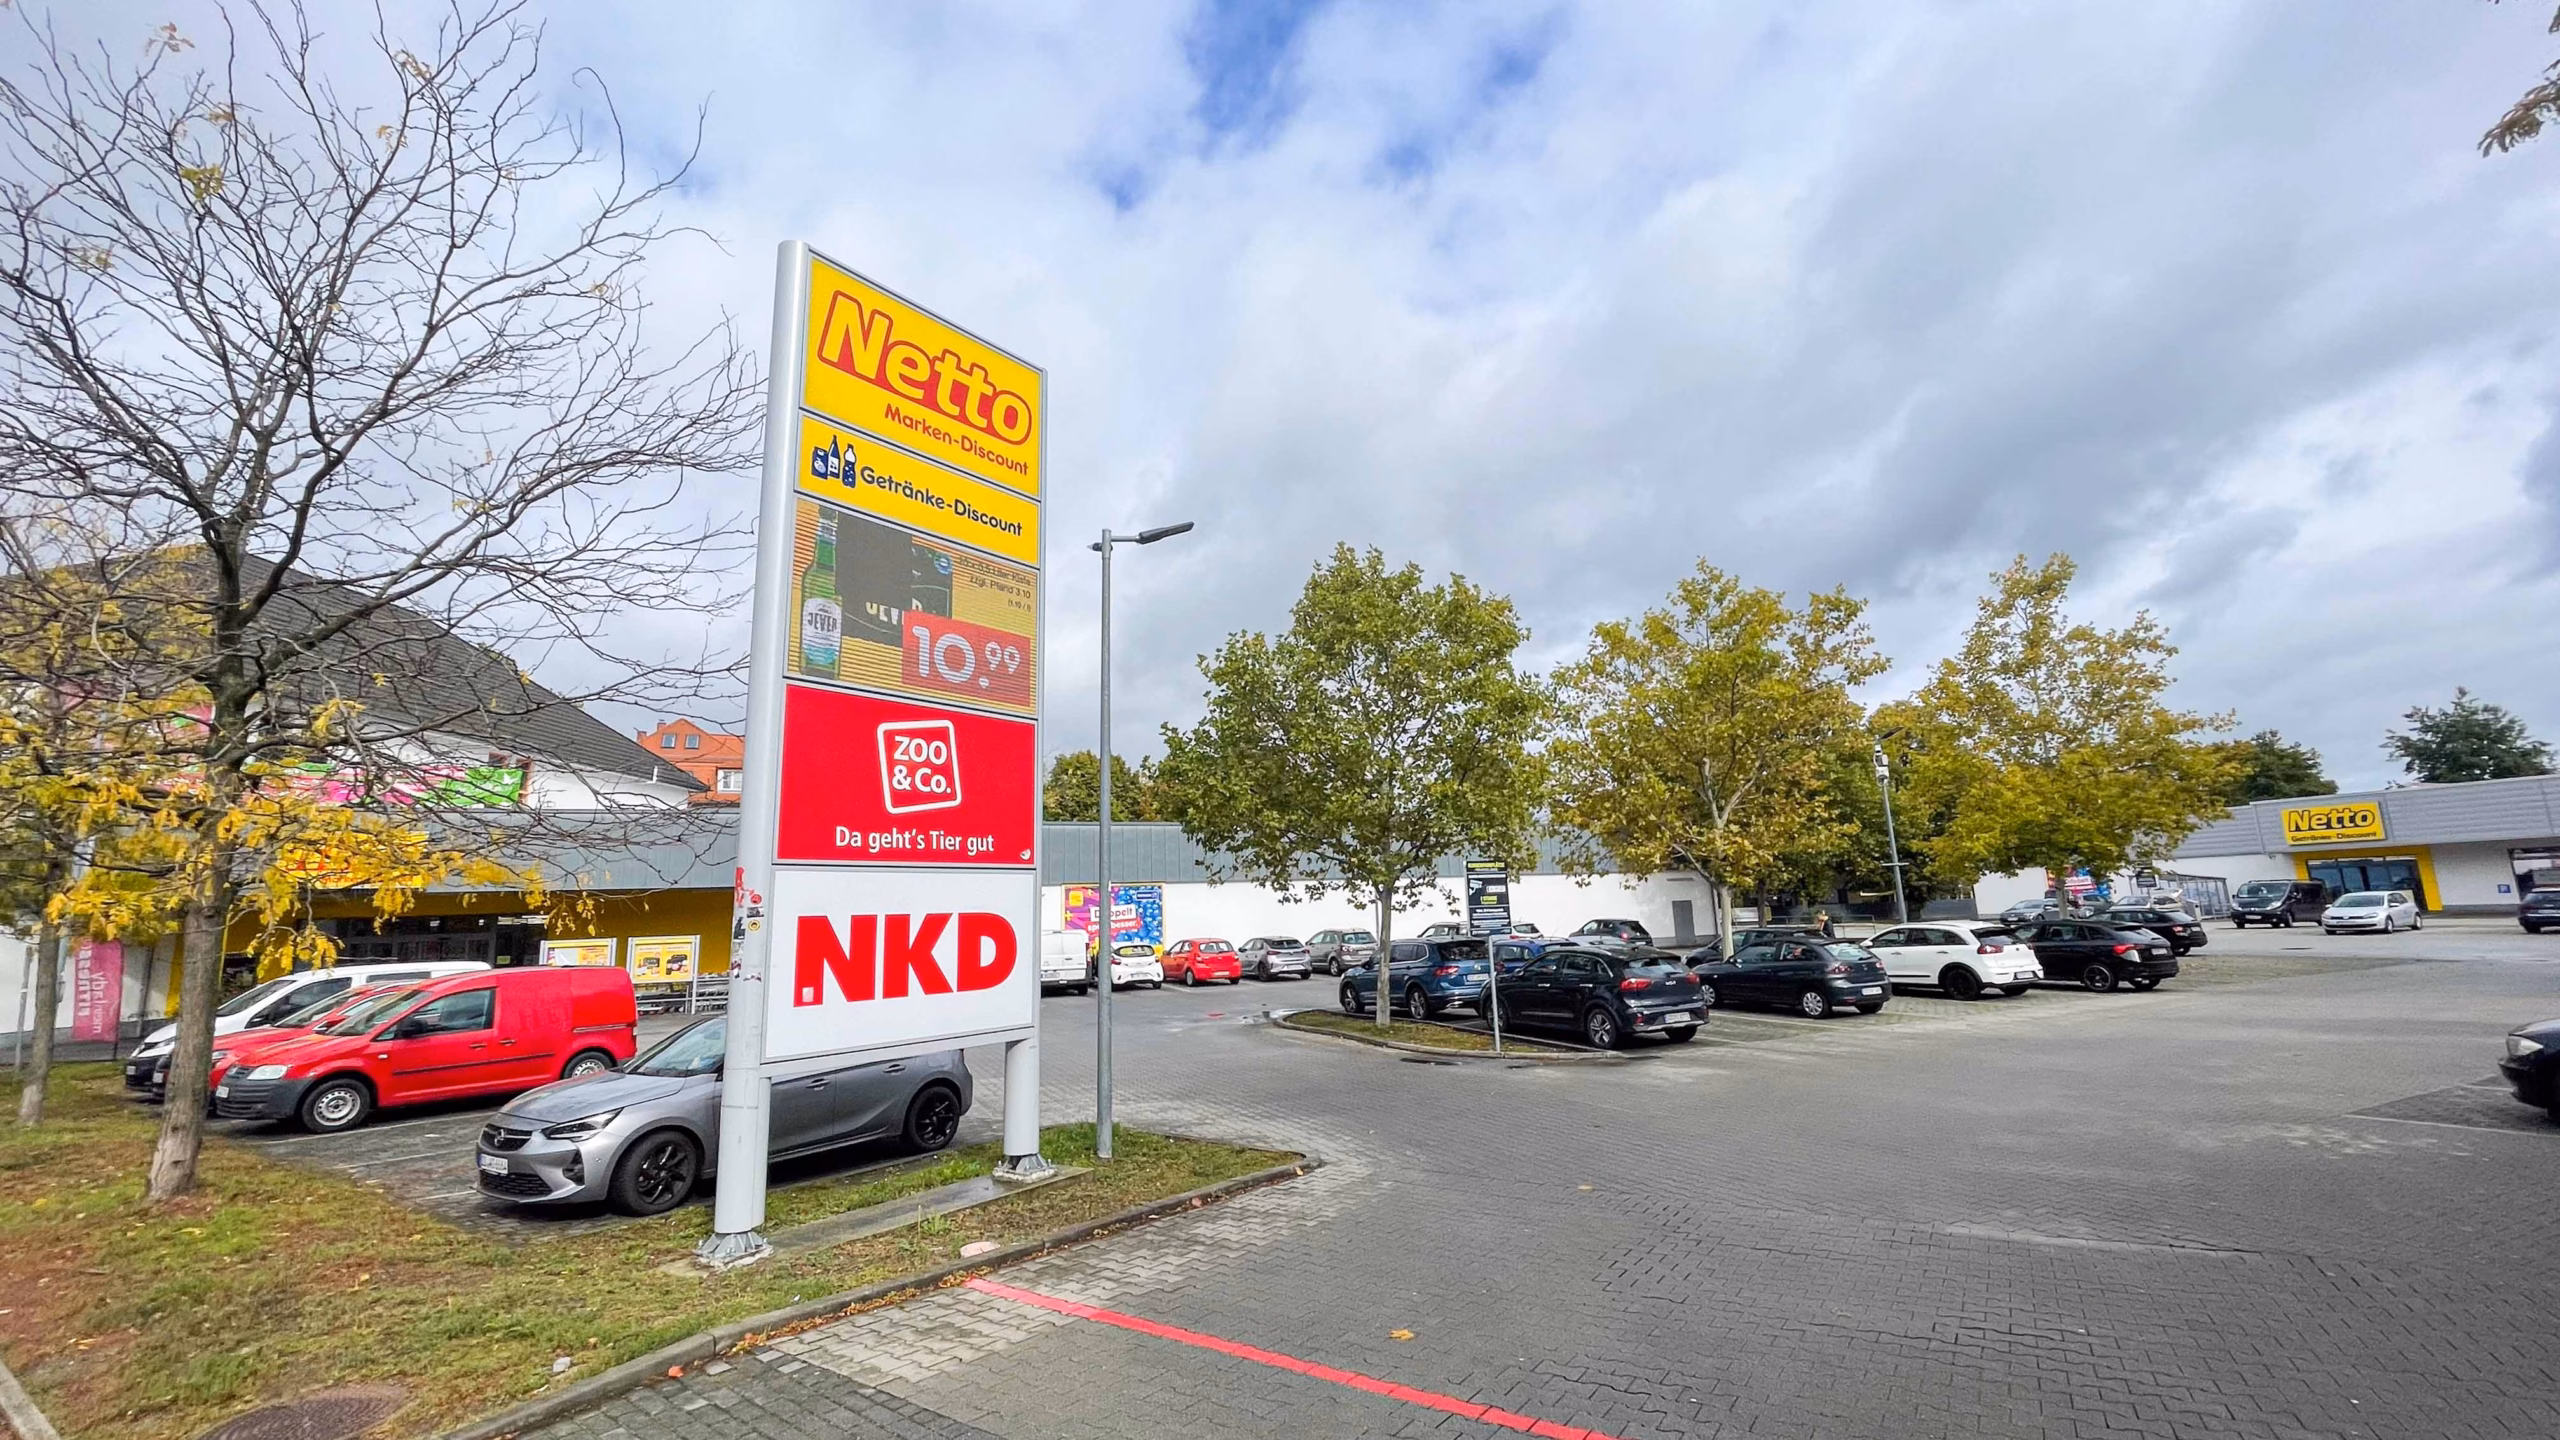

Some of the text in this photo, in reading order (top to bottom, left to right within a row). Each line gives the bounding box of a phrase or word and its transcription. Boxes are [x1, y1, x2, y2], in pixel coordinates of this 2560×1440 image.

[818, 290, 1032, 445] Netto
[885, 403, 1029, 476] Marken-Discount
[860, 466, 1023, 537] Getränke-Discount
[808, 612, 837, 632] JEVER
[912, 626, 1021, 689] 10.99
[893, 735, 947, 765] ZOO
[836, 826, 861, 848] Da
[930, 830, 961, 851] Tier
[967, 834, 994, 857] gut
[2289, 808, 2375, 831] Netto
[1095, 907, 1132, 919] Dpelt
[793, 912, 1017, 1008] NKD
